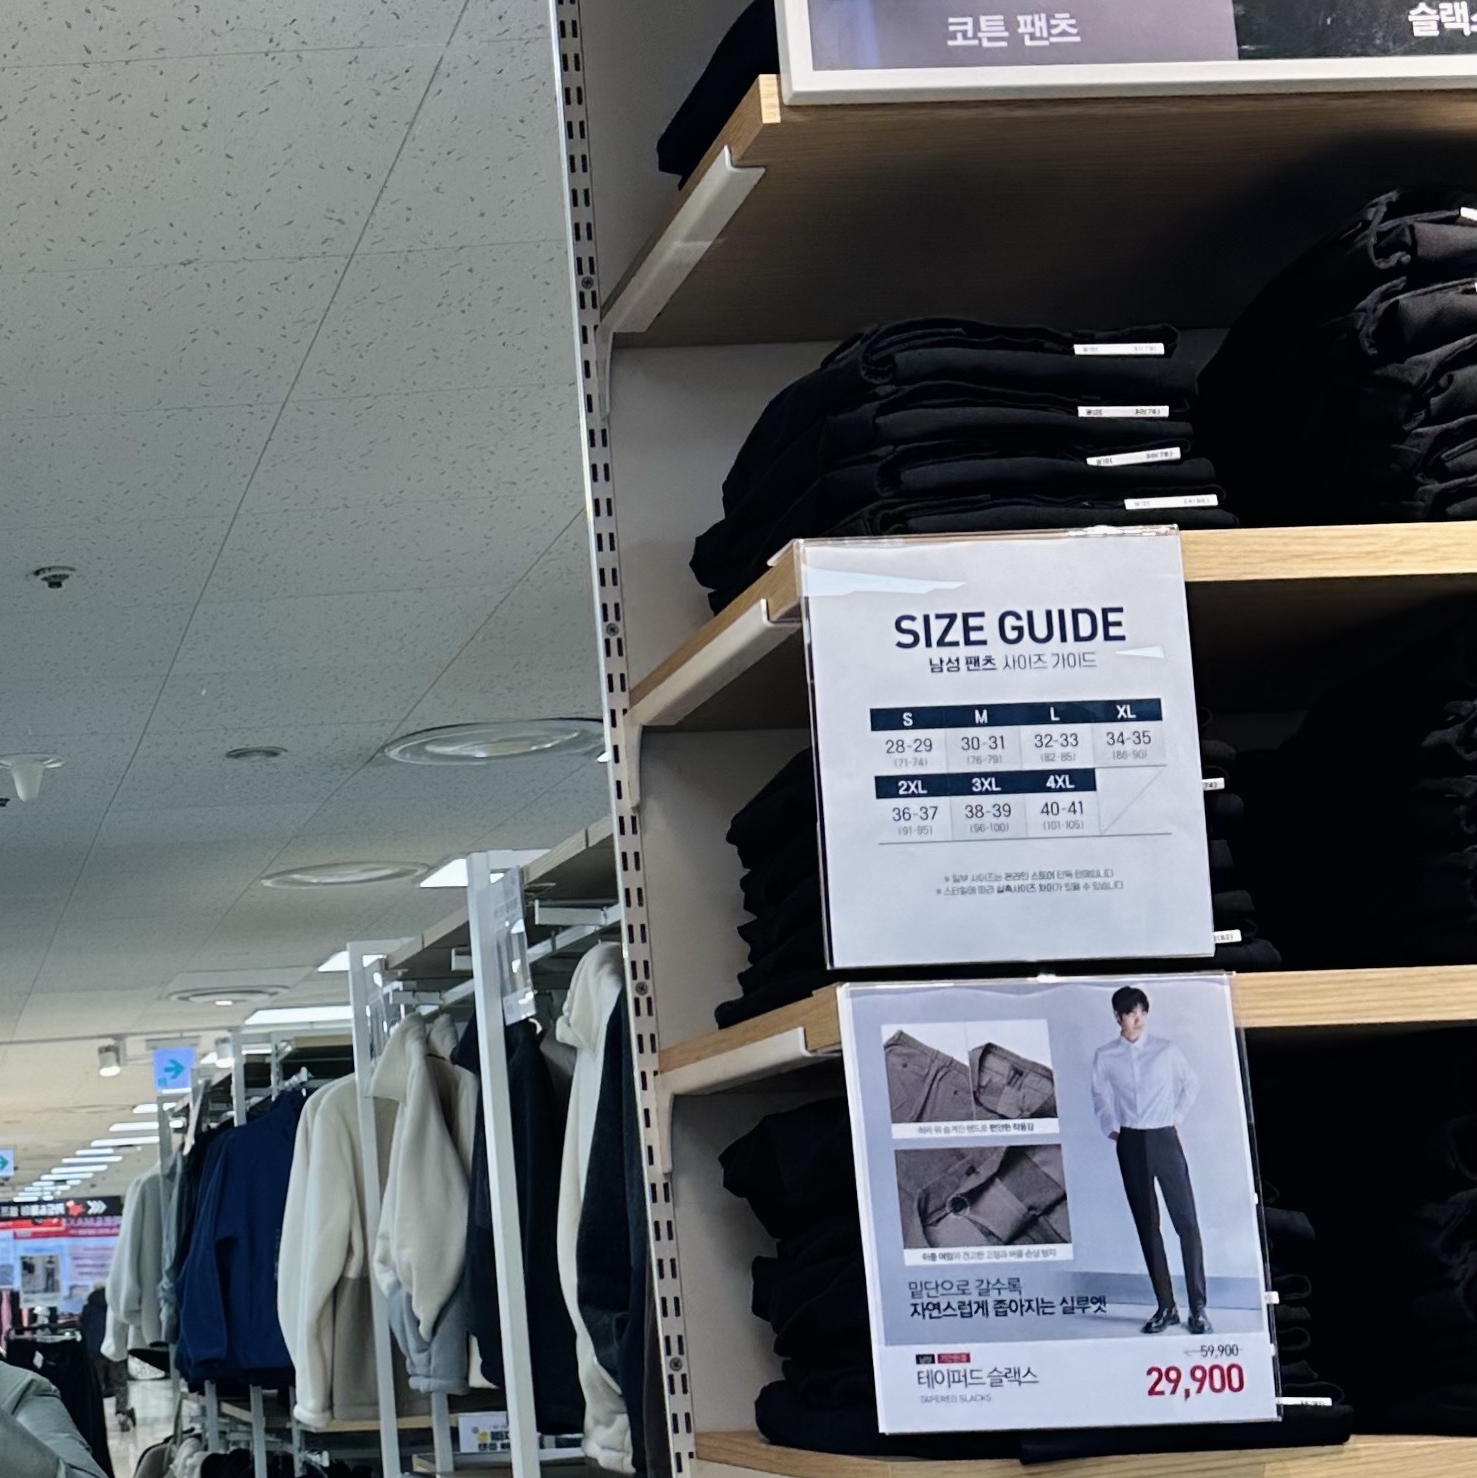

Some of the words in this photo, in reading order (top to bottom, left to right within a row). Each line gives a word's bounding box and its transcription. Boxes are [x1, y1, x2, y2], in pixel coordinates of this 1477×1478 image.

[947, 14, 1009, 48] 코튼
[1017, 12, 1081, 46] 팬츠
[1408, 1, 1477, 37] 슬랙
[895, 611, 988, 649] SIZE
[998, 607, 1126, 645] GUIDE
[929, 656, 961, 674] 남성
[965, 654, 997, 672] 팬츠
[1003, 653, 1048, 670] 사이즈
[1052, 651, 1097, 669] 가이드
[902, 712, 913, 726] S
[975, 709, 988, 724] M
[1050, 707, 1060, 721] L
[1116, 704, 1136, 719] XL
[885, 738, 933, 754] 28-29
[961, 735, 1005, 751] 30-31
[1034, 733, 1079, 748] 32-33
[1106, 730, 1152, 746] 34-35
[898, 780, 928, 795] 2XL
[971, 777, 1001, 792] 3XL
[1046, 775, 1075, 789] 4XL
[892, 806, 938, 822] 36-37
[965, 803, 1012, 819] 38-39
[1040, 800, 1084, 816] 40-41
[909, 1280, 972, 1299] 밑단으로
[975, 1277, 1023, 1296] 갈수록
[910, 1299, 989, 1320] 자연스럽게
[993, 1297, 1055, 1317] 좁아지는
[1059, 1295, 1107, 1315] 실루엣
[1201, 1344, 1239, 1359] 59,900
[917, 1367, 986, 1389] 테이퍼드
[987, 1366, 1039, 1387] 슬랙스
[1146, 1363, 1245, 1401] 29,900
[920, 1395, 958, 1404] TAPERED
[959, 1394, 992, 1403] SLACKS
